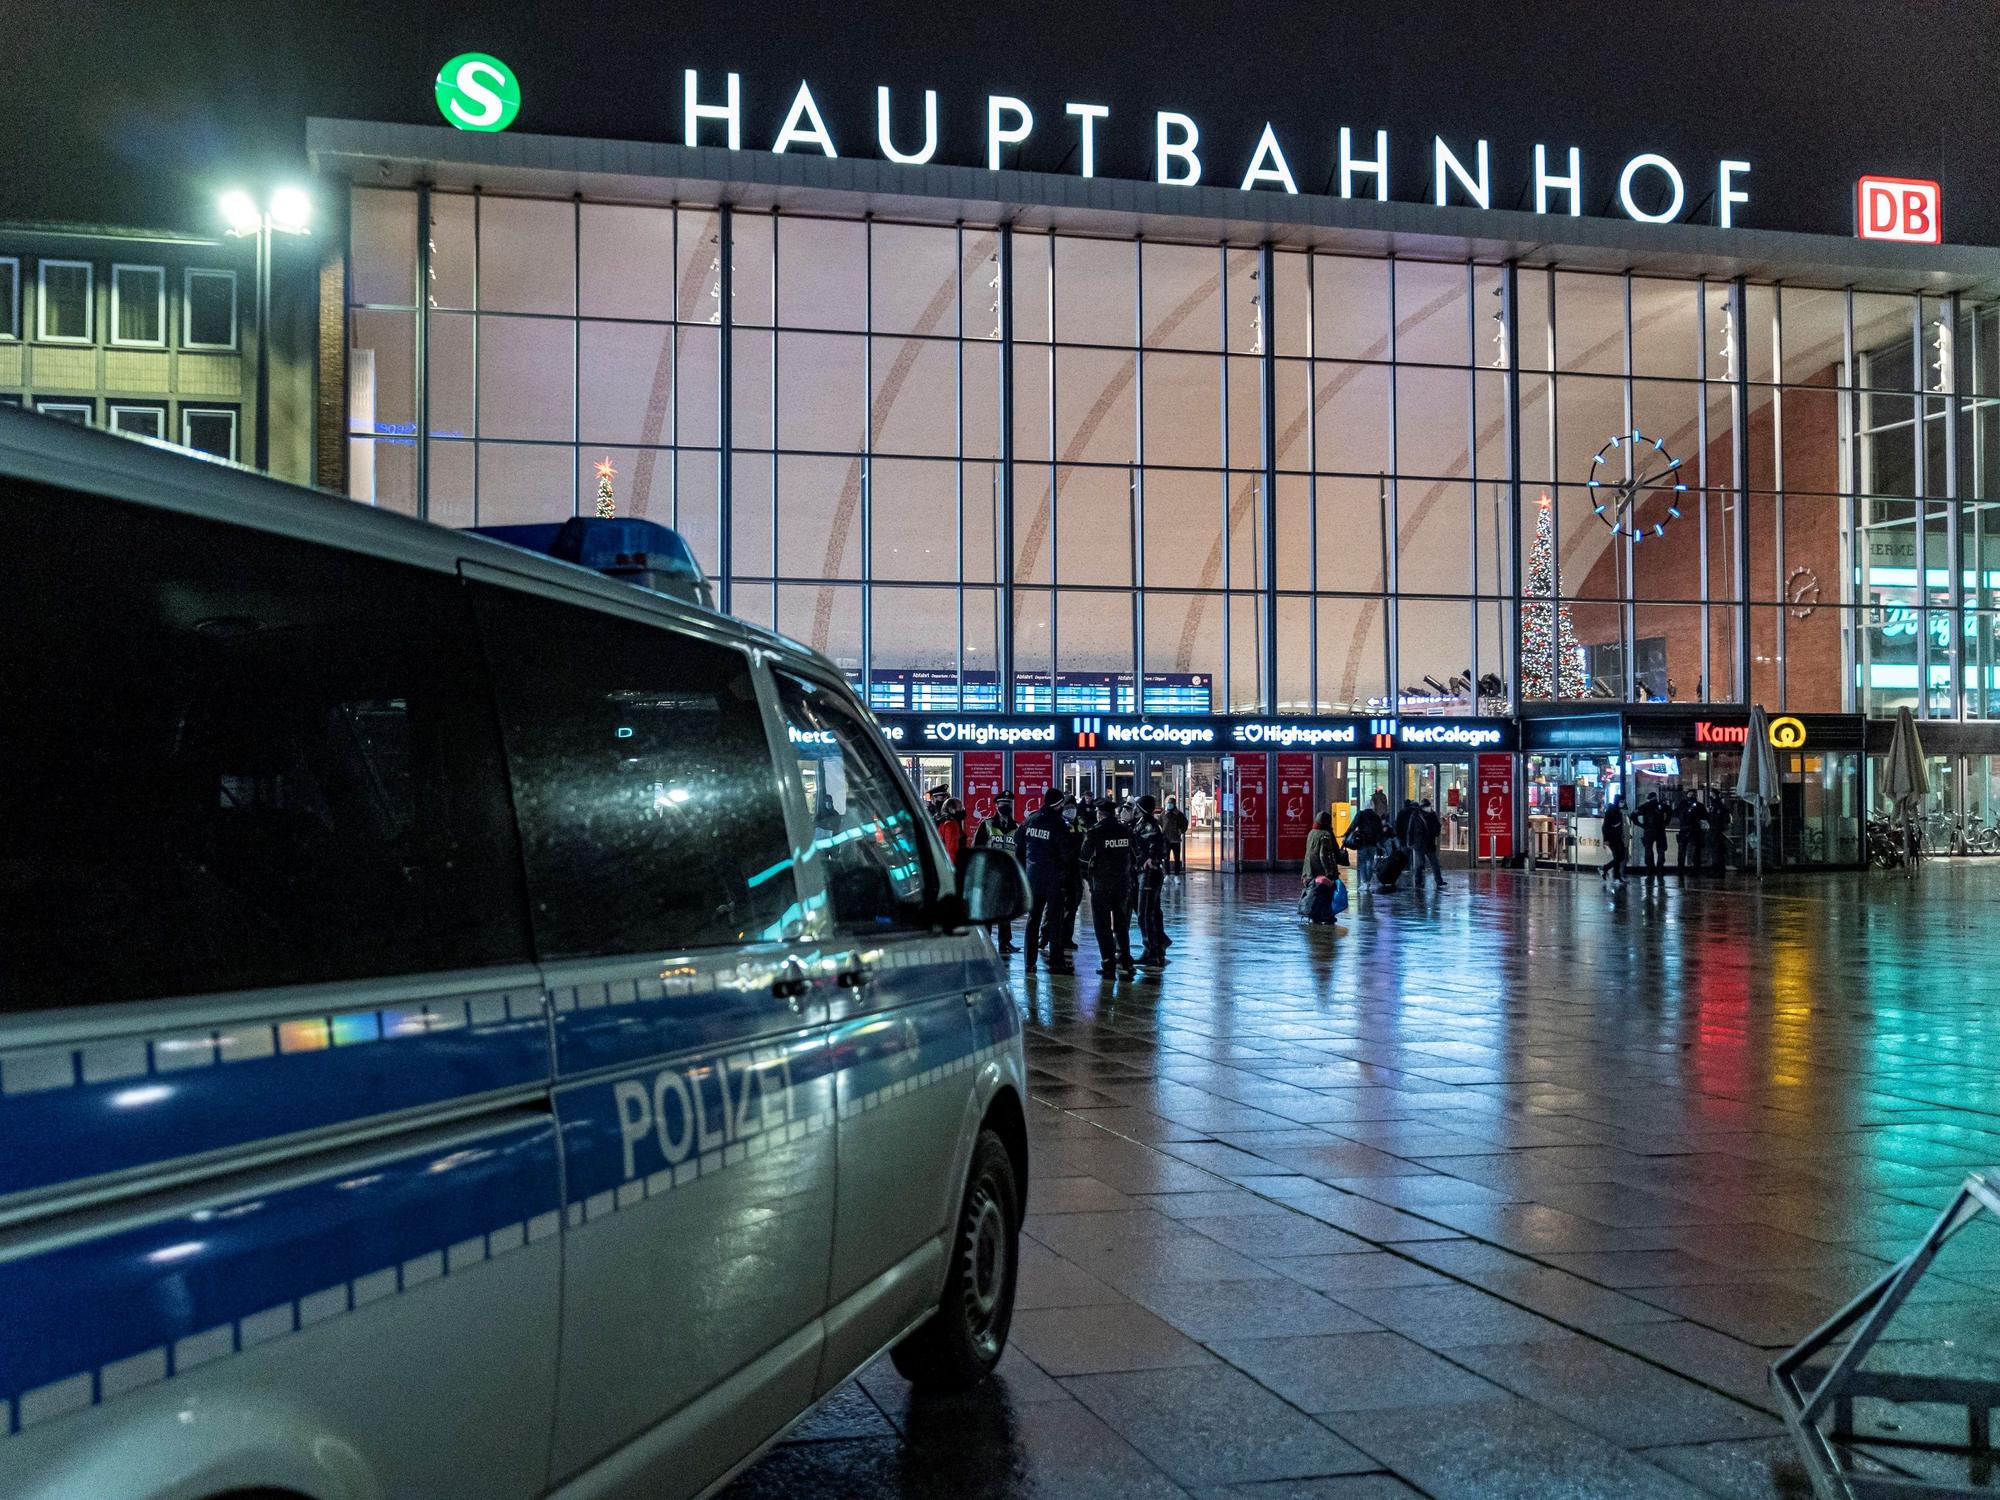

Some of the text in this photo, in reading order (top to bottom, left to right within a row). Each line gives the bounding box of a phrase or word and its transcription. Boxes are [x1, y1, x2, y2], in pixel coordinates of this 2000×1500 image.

[450, 61, 506, 127] S
[683, 69, 1751, 228] HAUPTBAHNHOF
[1869, 187, 1930, 234] DB
[957, 723, 1055, 745] Highspeed
[1107, 724, 1214, 743] NetCologne
[1263, 725, 1354, 746] Highspeed
[1402, 726, 1501, 743] NetCologne
[1695, 722, 1749, 744] Kam
[991, 835, 1015, 845] POLIZ
[1025, 827, 1050, 840] POLIZEI
[1104, 838, 1129, 849] POLIZEI
[615, 1055, 794, 1179] POLIZEI
